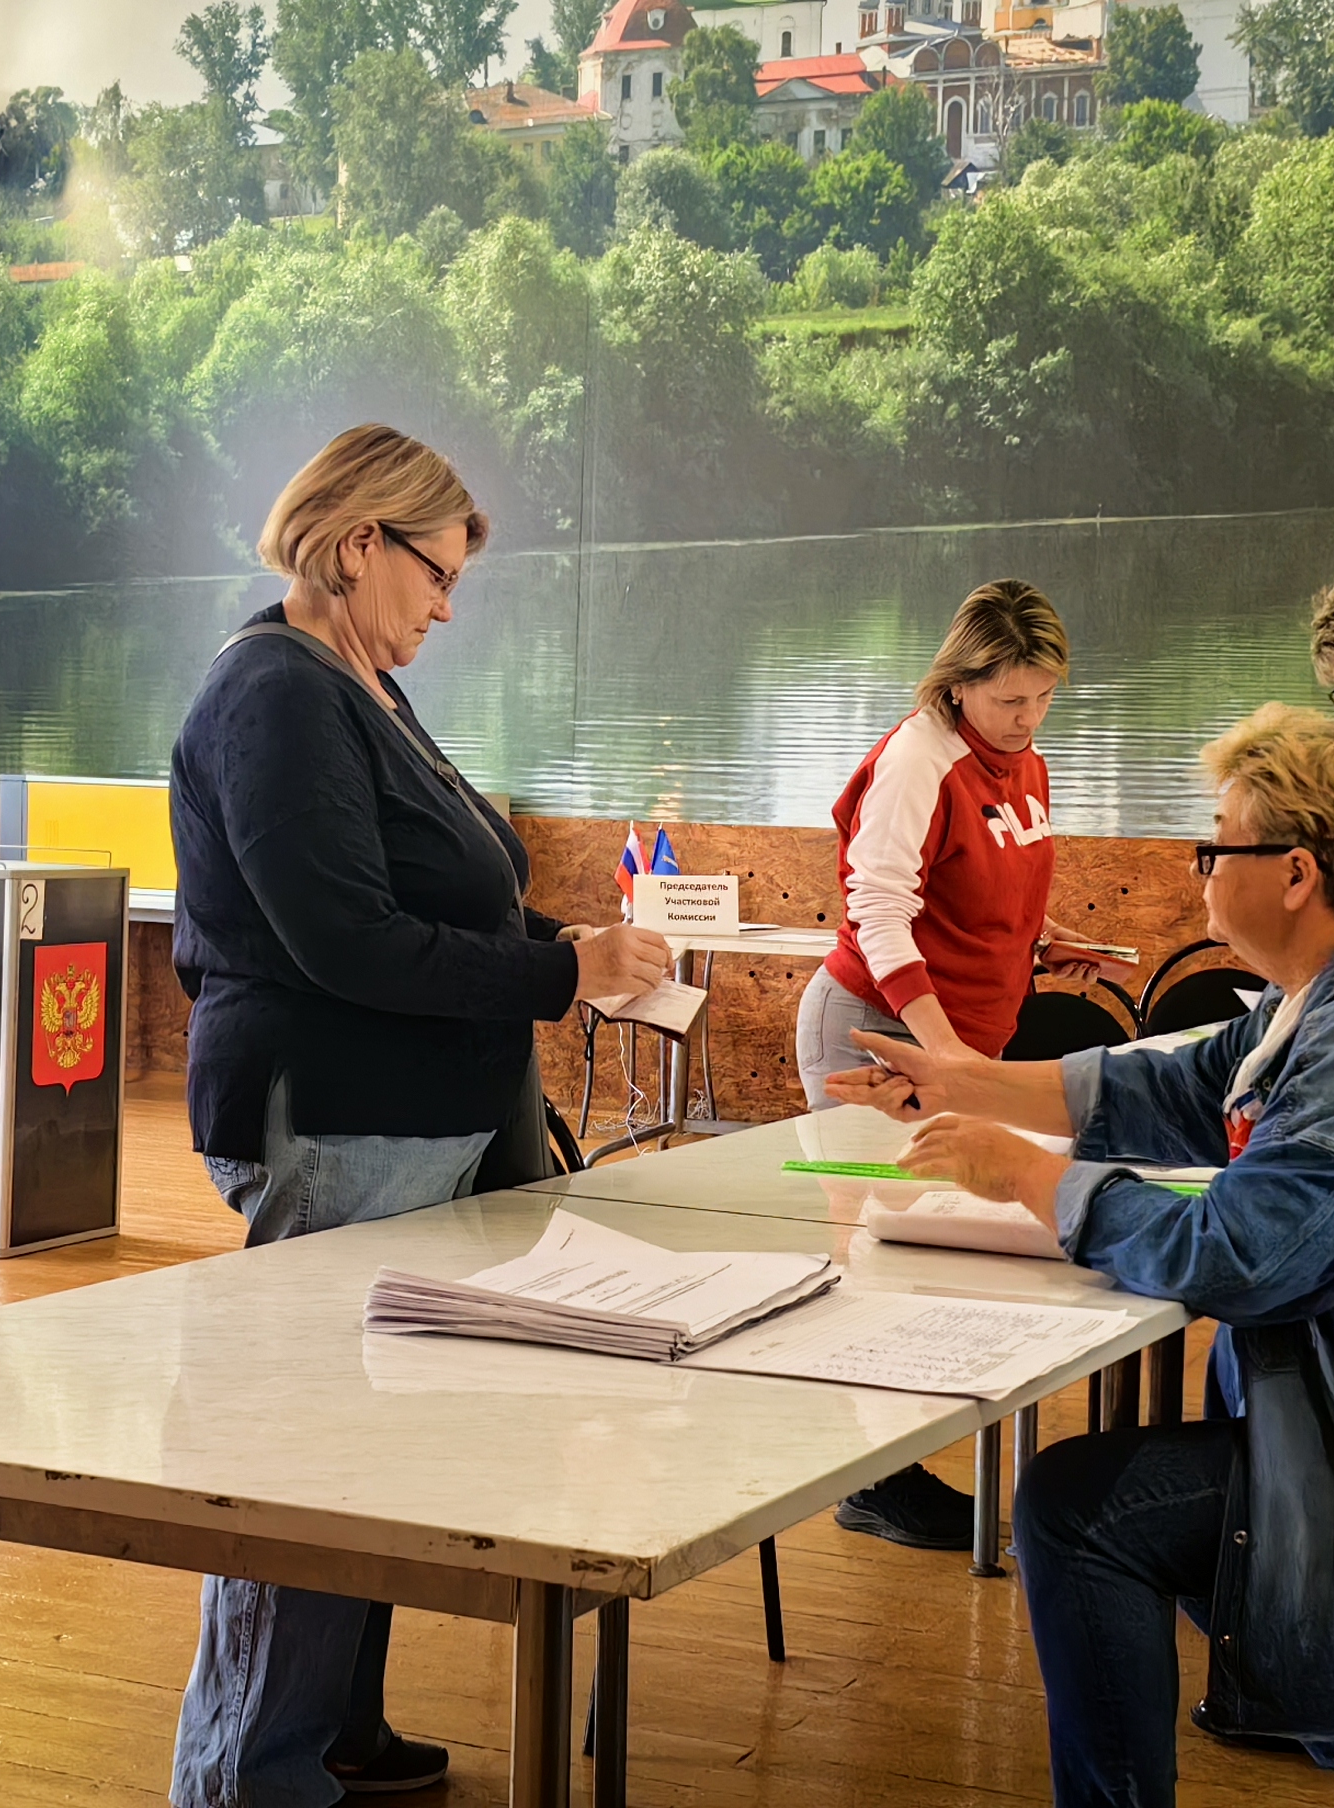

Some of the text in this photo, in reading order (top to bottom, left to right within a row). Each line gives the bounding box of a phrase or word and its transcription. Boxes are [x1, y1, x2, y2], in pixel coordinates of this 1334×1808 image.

[981, 793, 1052, 849] FILA
[659, 881, 729, 892] Председатель
[664, 896, 720, 906] Участковой
[21, 883, 39, 934] 2
[667, 912, 716, 921] Комиссии
